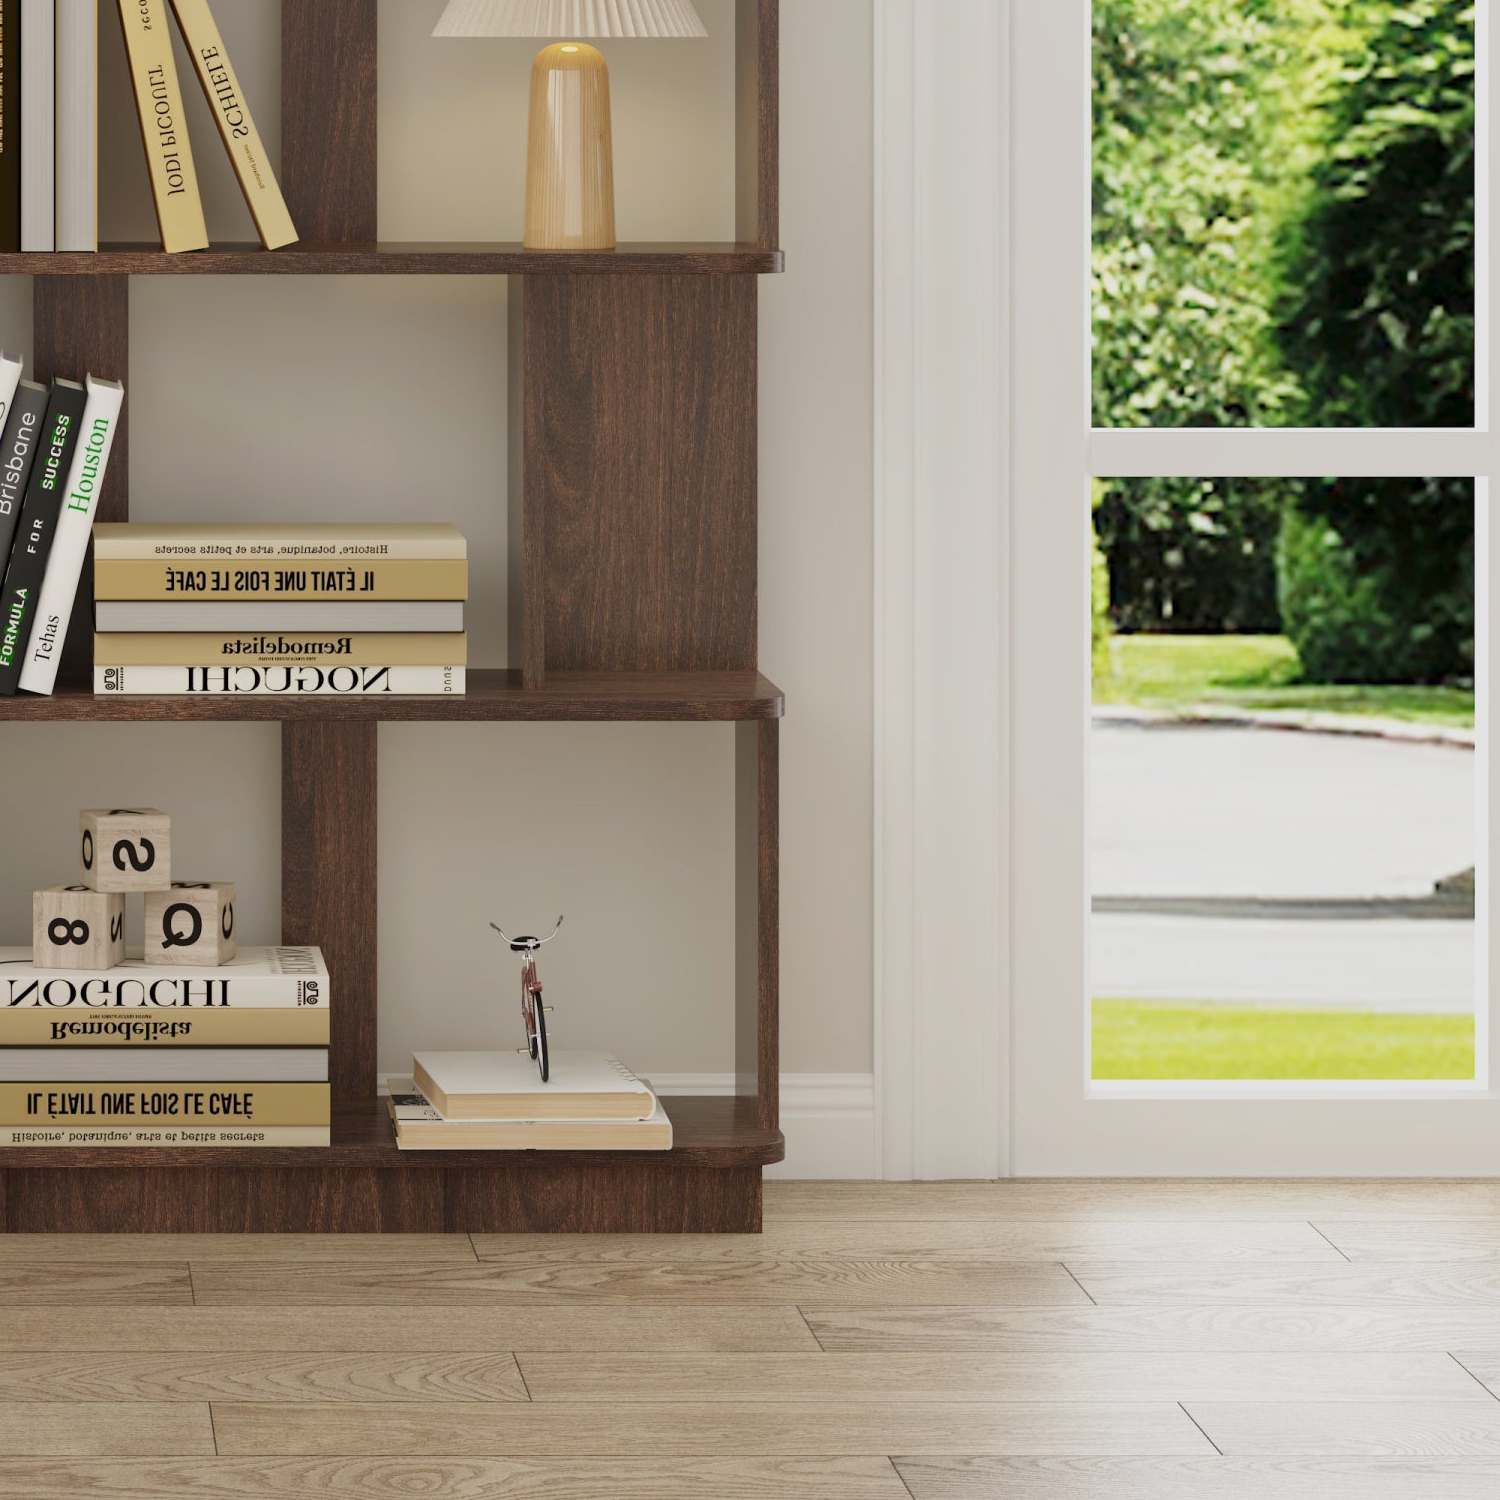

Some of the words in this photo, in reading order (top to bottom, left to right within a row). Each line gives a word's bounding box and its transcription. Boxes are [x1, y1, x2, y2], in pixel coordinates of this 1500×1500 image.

[26, 519, 44, 554] FOR
[42, 414, 71, 491] SUCCESS
[33, 615, 60, 662] Tehas
[68, 419, 109, 515] Houston
